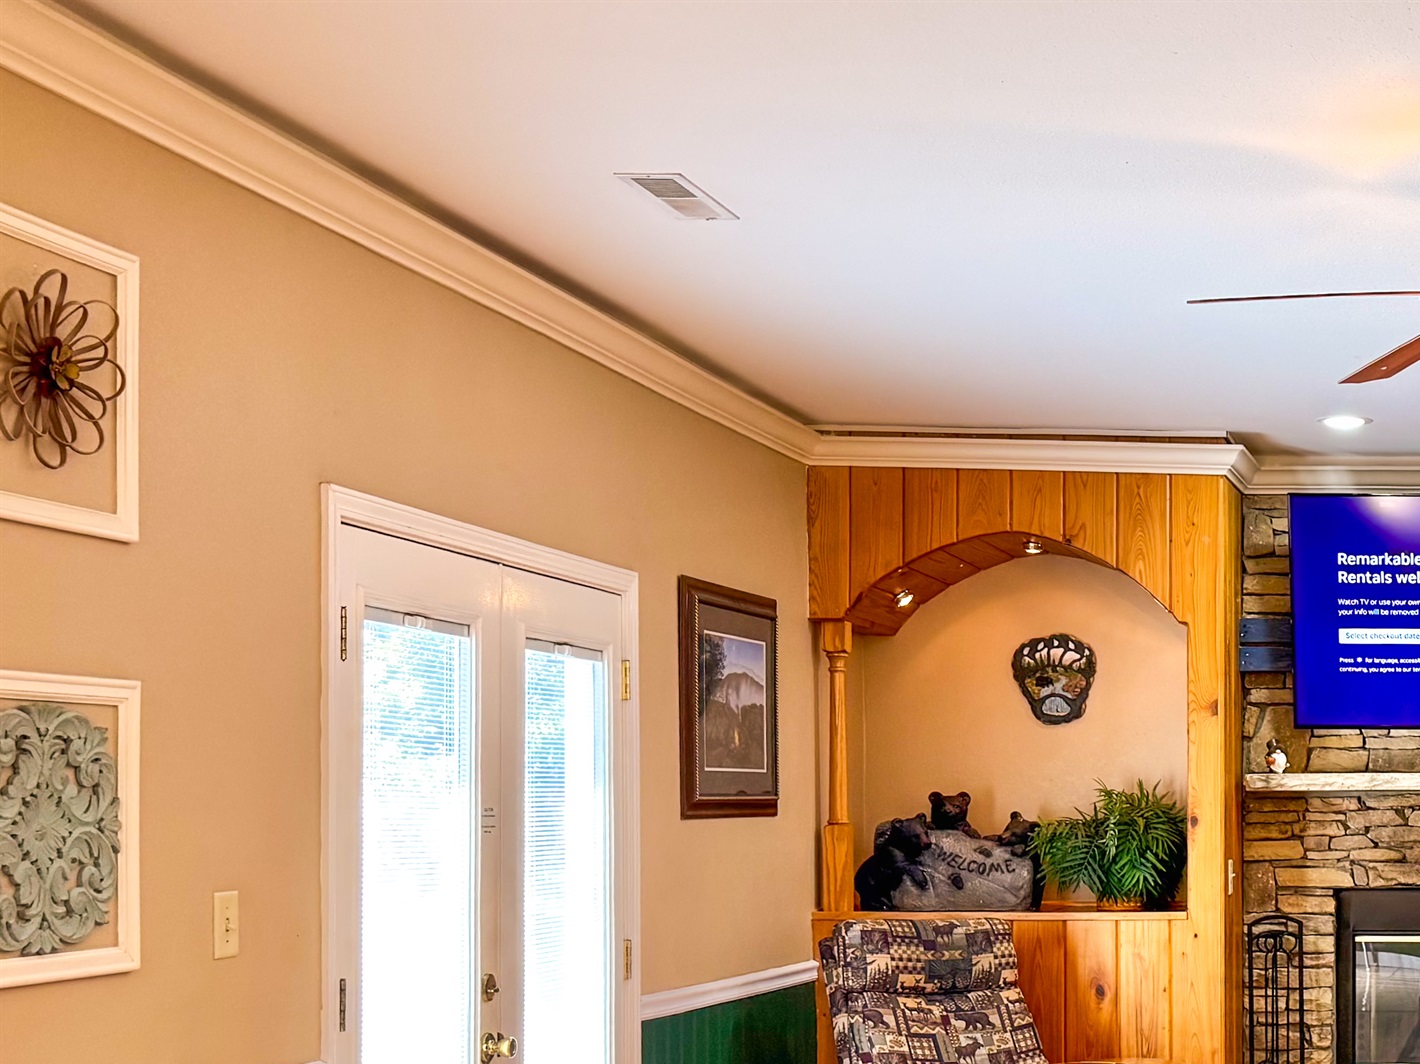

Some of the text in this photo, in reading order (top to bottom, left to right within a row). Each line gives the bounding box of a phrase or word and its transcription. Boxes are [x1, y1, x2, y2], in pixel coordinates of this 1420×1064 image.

[1337, 571, 1393, 584] Rentals
[1337, 598, 1359, 606] Watch
[1360, 598, 1370, 606] TV
[1391, 599, 1407, 607] your
[1337, 609, 1353, 617] your
[1354, 608, 1368, 616] info
[1380, 608, 1389, 616] be
[1390, 608, 1419, 616] removed
[1345, 631, 1420, 640] Select checkout date
[936, 847, 1016, 877] WELCOME
